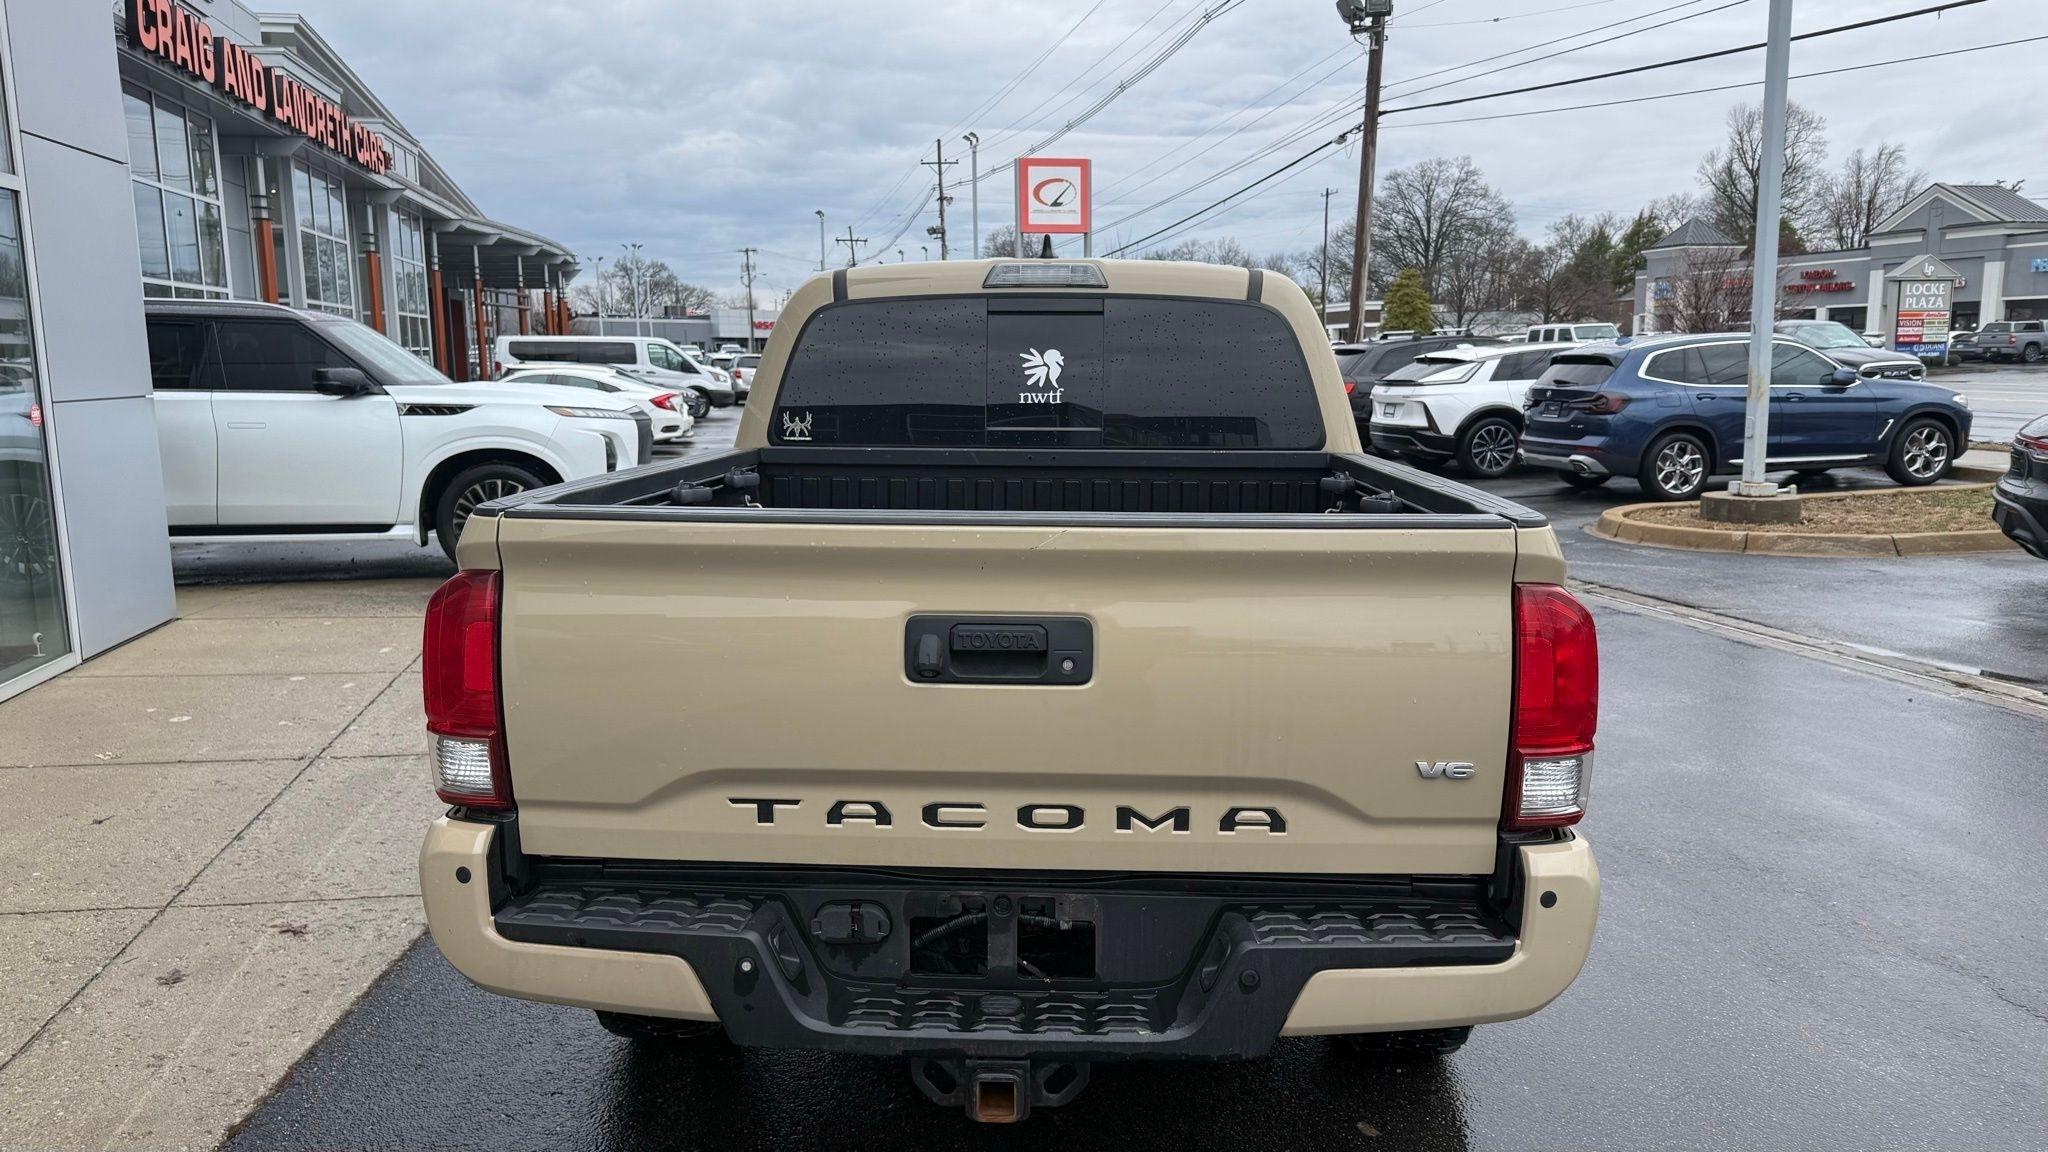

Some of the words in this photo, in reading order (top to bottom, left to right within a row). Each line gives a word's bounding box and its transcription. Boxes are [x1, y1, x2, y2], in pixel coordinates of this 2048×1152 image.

[135, 0, 216, 84] CRAIG
[223, 37, 267, 112] AND
[270, 67, 352, 159] LANDRETH
[353, 121, 386, 176] CARS
[1905, 283, 1946, 295] LOCKE
[1905, 296, 1945, 309] PLAZA
[1899, 319, 1922, 327] VISION
[1018, 388, 1064, 404] nwtf
[958, 632, 1040, 649] TOYOTA
[1415, 761, 1475, 779] V6
[728, 798, 1288, 833] TACOMA
